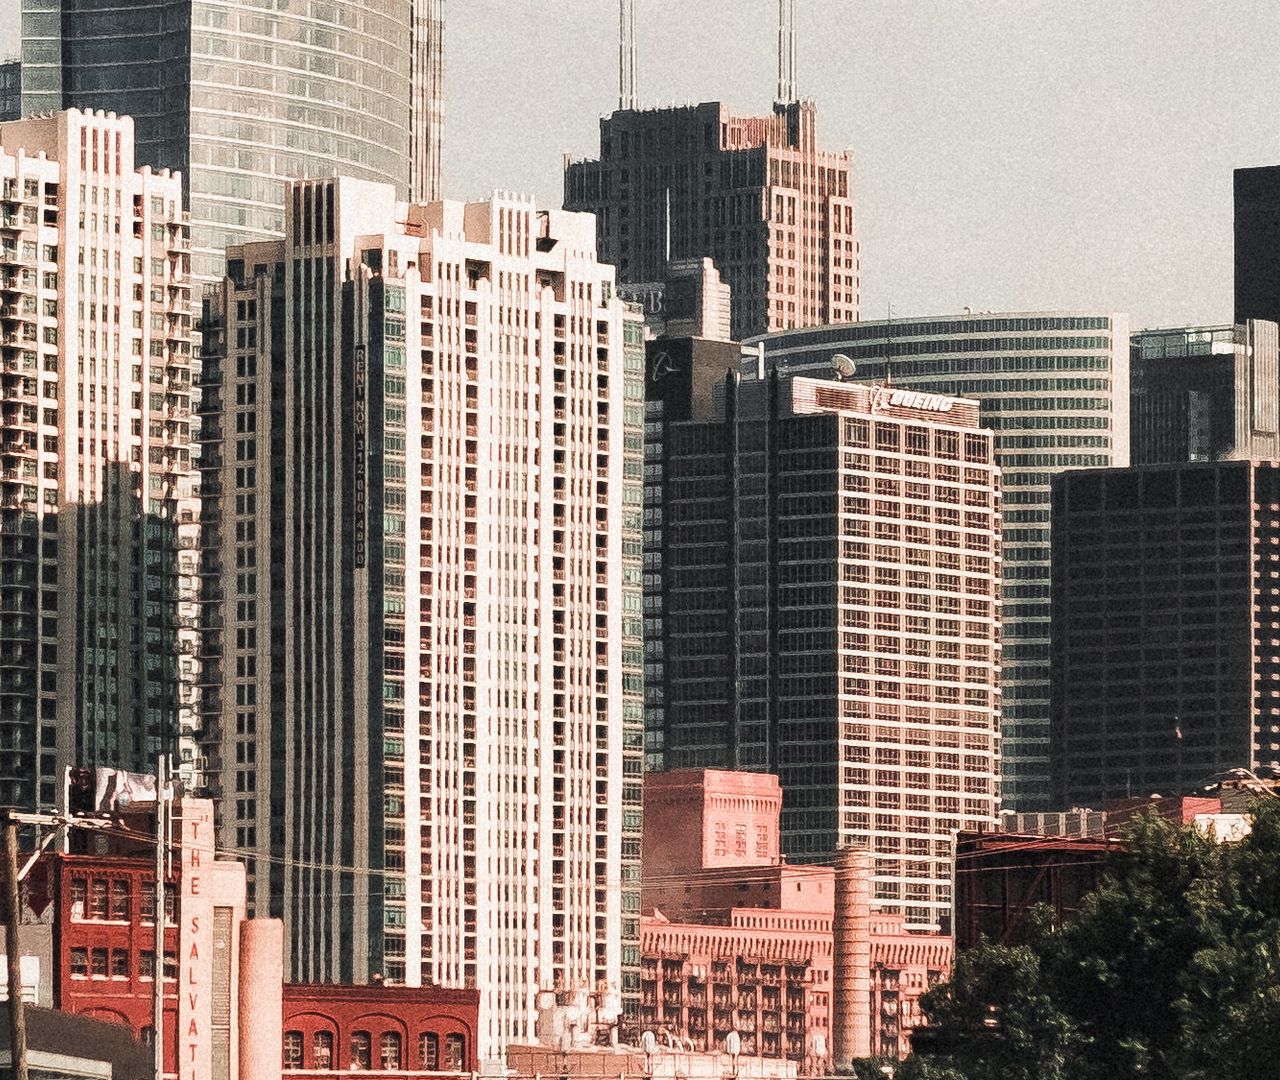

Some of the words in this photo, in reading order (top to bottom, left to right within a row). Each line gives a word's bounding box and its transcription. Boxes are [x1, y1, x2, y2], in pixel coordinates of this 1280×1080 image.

[356, 348, 365, 396] RENT
[355, 400, 365, 434] NOW
[889, 391, 953, 411] BOEING
[191, 822, 200, 895] THE
